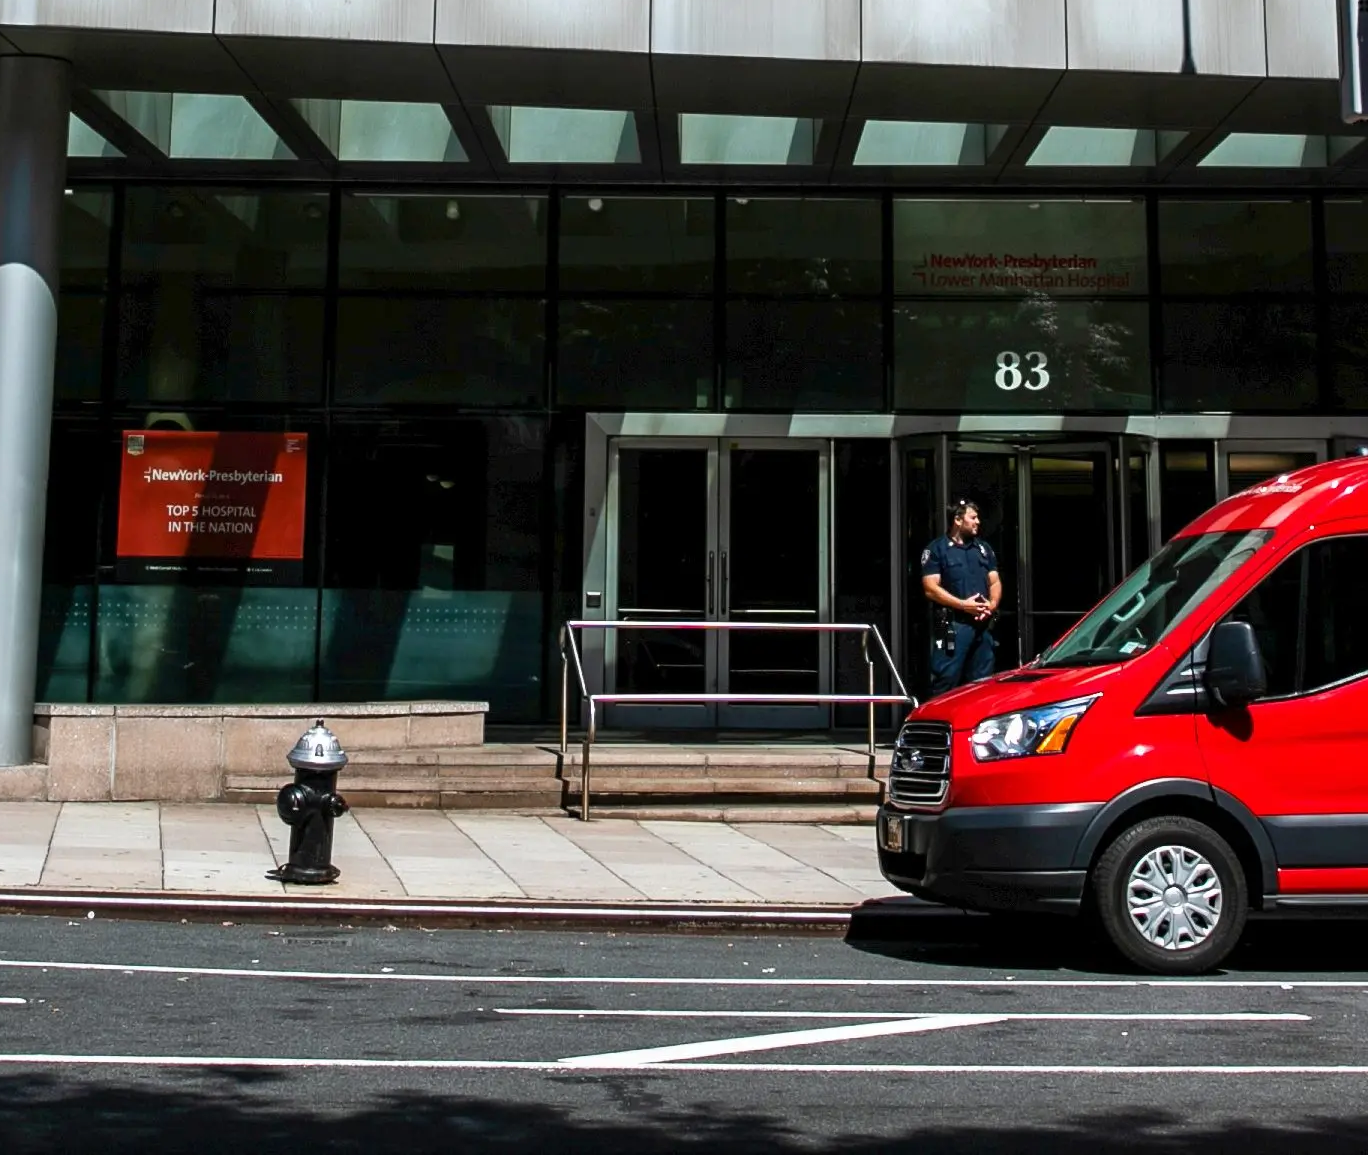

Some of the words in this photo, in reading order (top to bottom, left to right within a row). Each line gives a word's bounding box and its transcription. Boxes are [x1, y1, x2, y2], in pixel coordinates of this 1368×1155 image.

[930, 253, 1097, 270] NewYork-Presbyterian
[931, 274, 975, 287] Lower
[981, 273, 1064, 287] Manhattan
[1068, 273, 1130, 291] Hospital
[994, 351, 1050, 391] 83
[152, 469, 283, 485] NewYork-Presbyterian
[166, 505, 190, 517] TOP
[191, 505, 199, 517] 5
[202, 506, 257, 518] HOSPITAL
[168, 521, 181, 532] IN
[184, 521, 206, 533] THE
[208, 522, 253, 534] NATION
